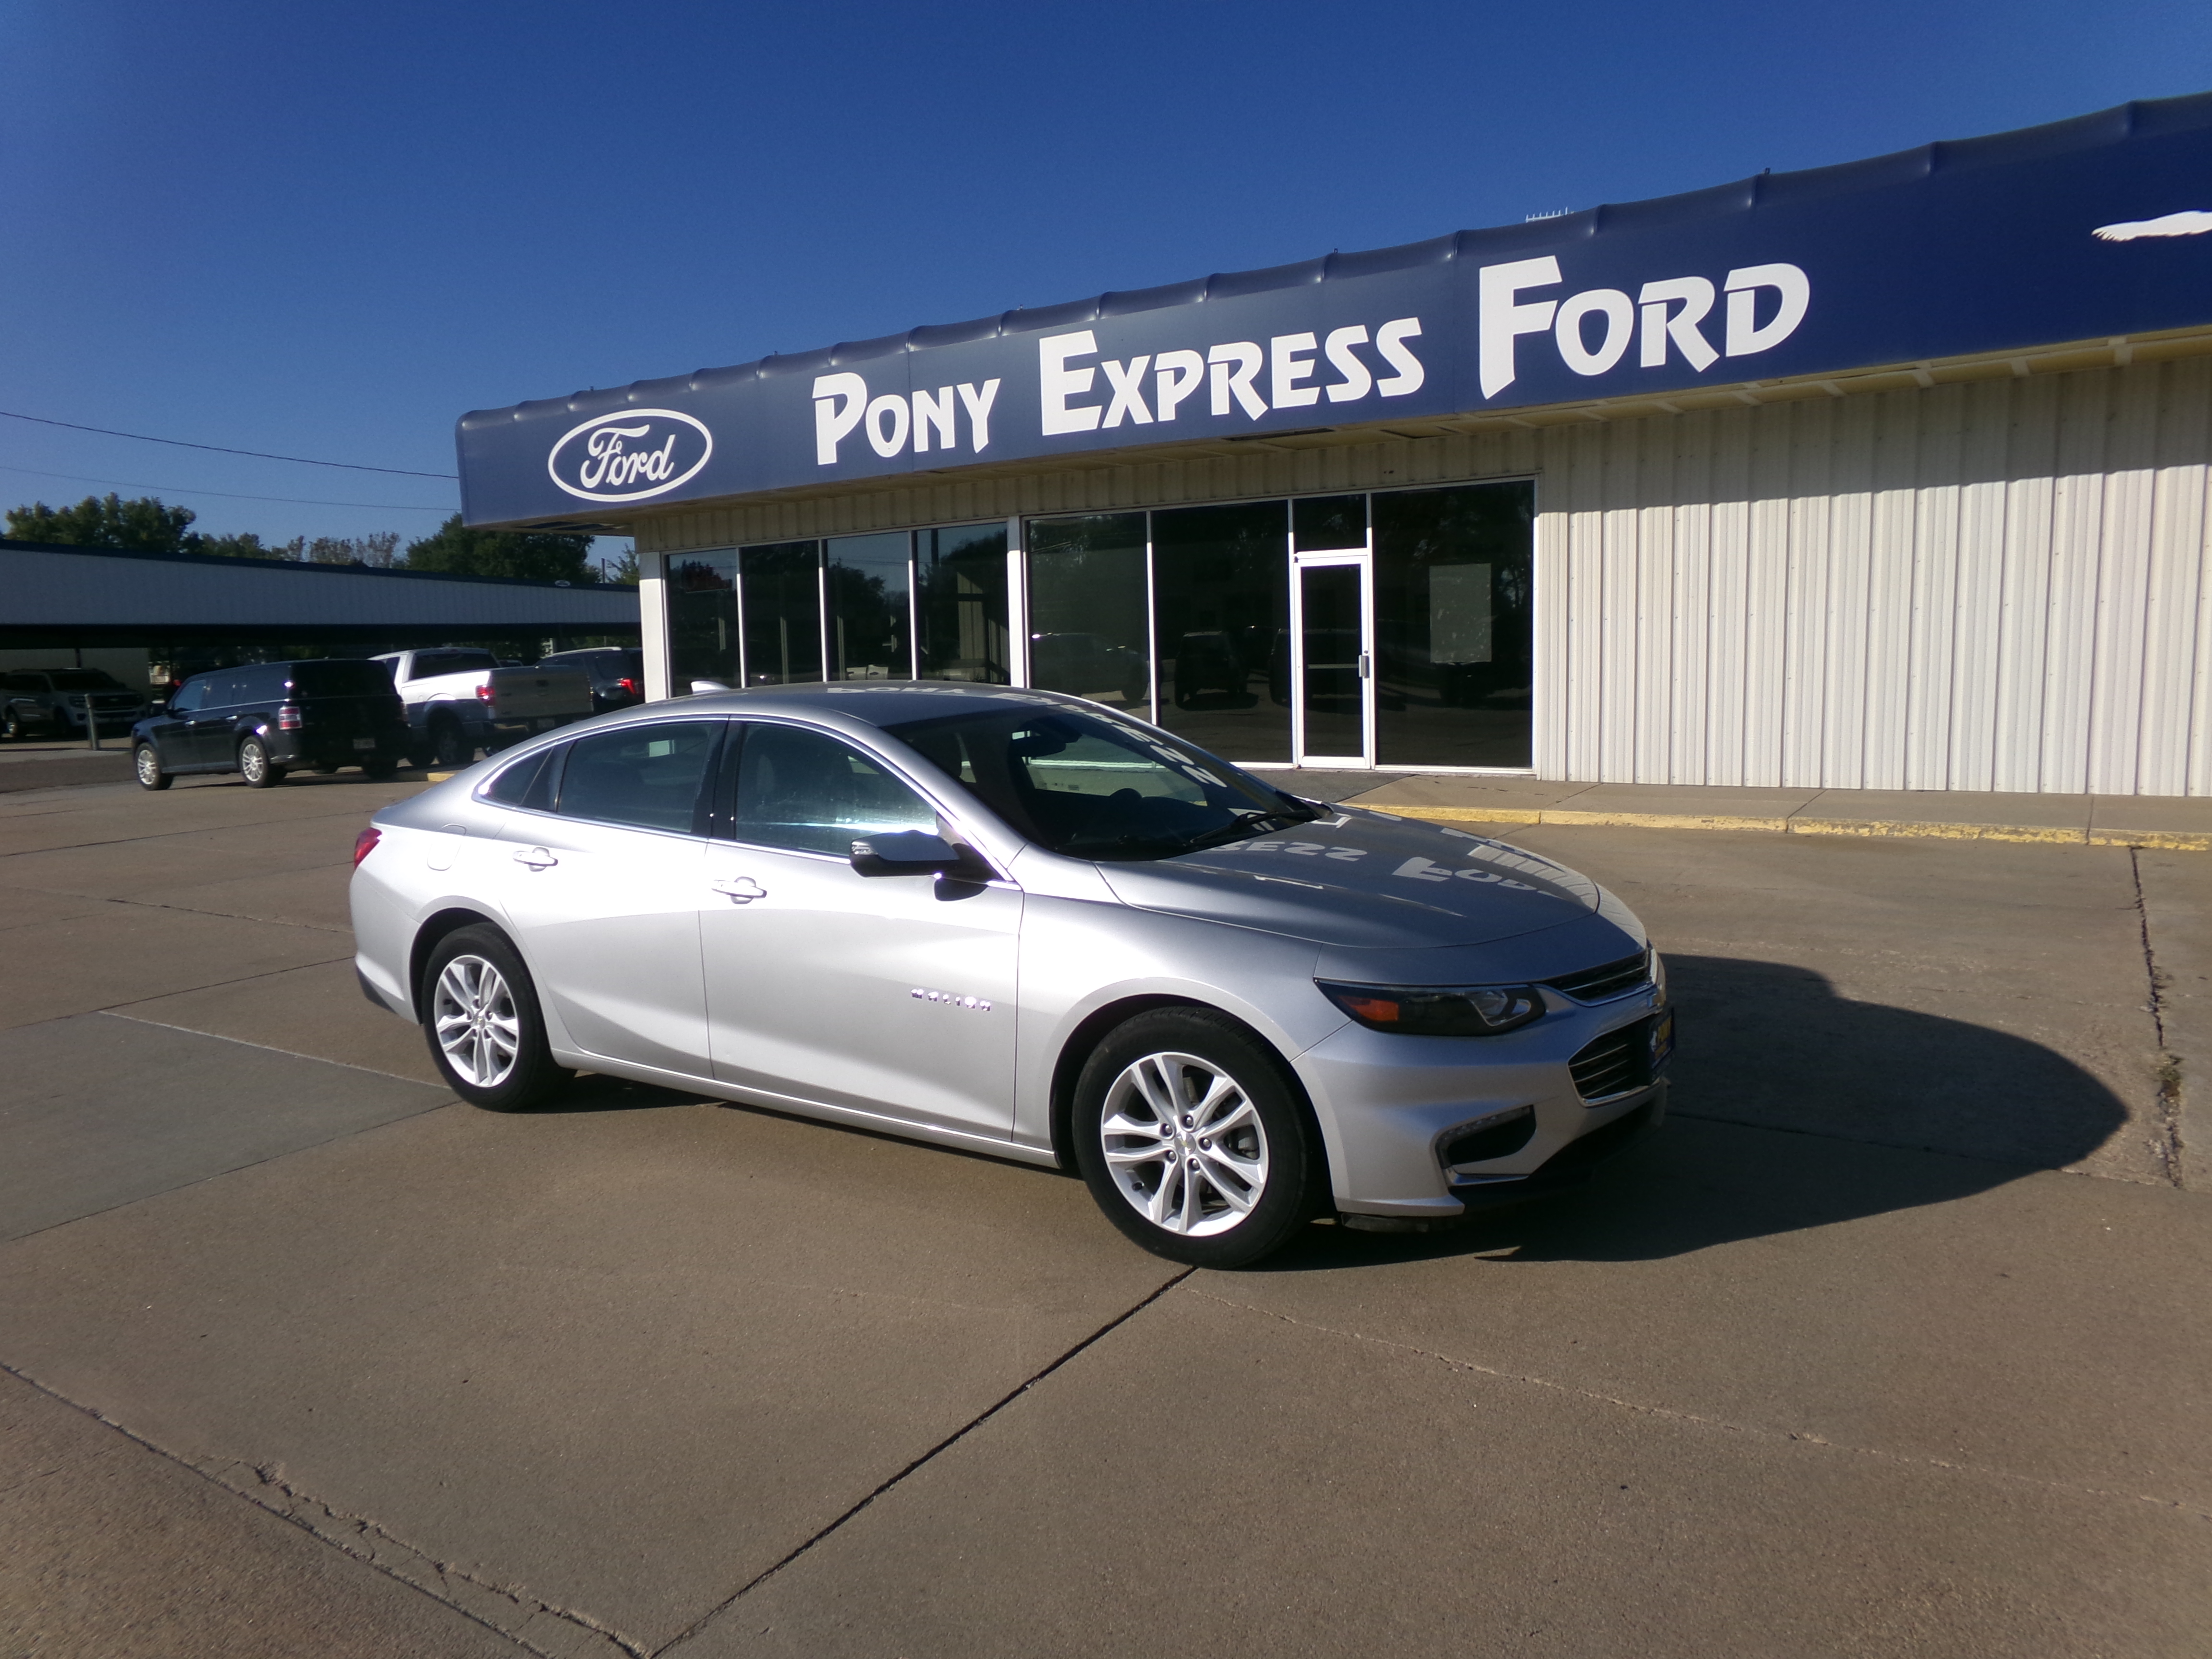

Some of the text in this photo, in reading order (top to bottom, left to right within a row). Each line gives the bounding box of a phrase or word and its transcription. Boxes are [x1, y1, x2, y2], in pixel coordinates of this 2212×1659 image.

[812, 255, 1810, 466] PONY EXPRESS FORD
[580, 424, 676, 489] Ford
